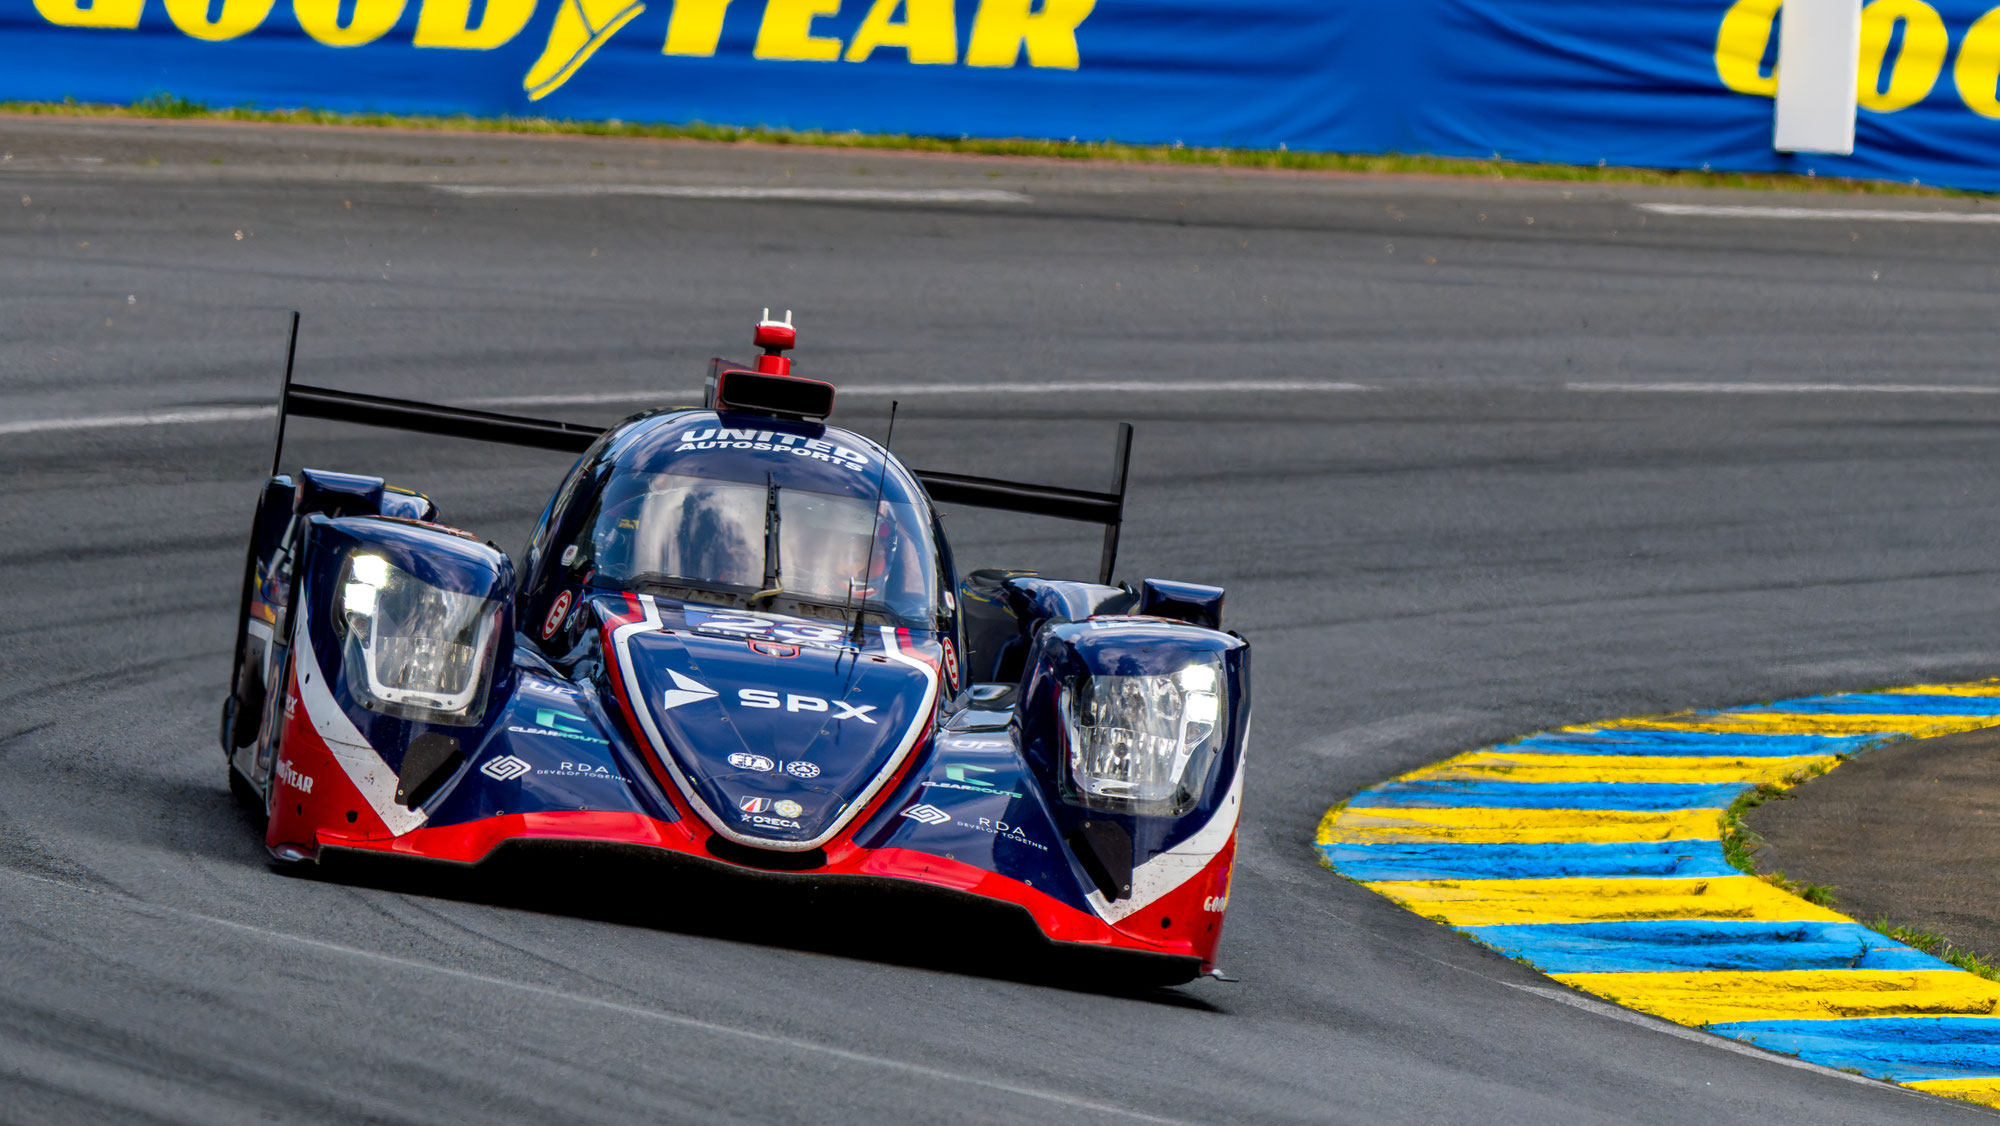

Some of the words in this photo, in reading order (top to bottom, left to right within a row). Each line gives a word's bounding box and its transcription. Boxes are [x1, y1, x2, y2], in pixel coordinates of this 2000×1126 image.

[675, 441, 863, 472] AUTOSPORTS
[681, 428, 869, 465] UNITED
[699, 614, 844, 642] 23
[738, 688, 878, 725] SPX
[508, 725, 610, 745] CLEARROUTE
[560, 761, 609, 774] RDA
[730, 753, 770, 769] FIA
[584, 772, 633, 784] TOGETHER
[921, 781, 1023, 799] CLEARROUTE
[752, 815, 801, 829] ORECA
[979, 817, 1026, 837] RDA
[957, 821, 999, 834] DEVELOP
[1002, 832, 1049, 851] TOGETHER
